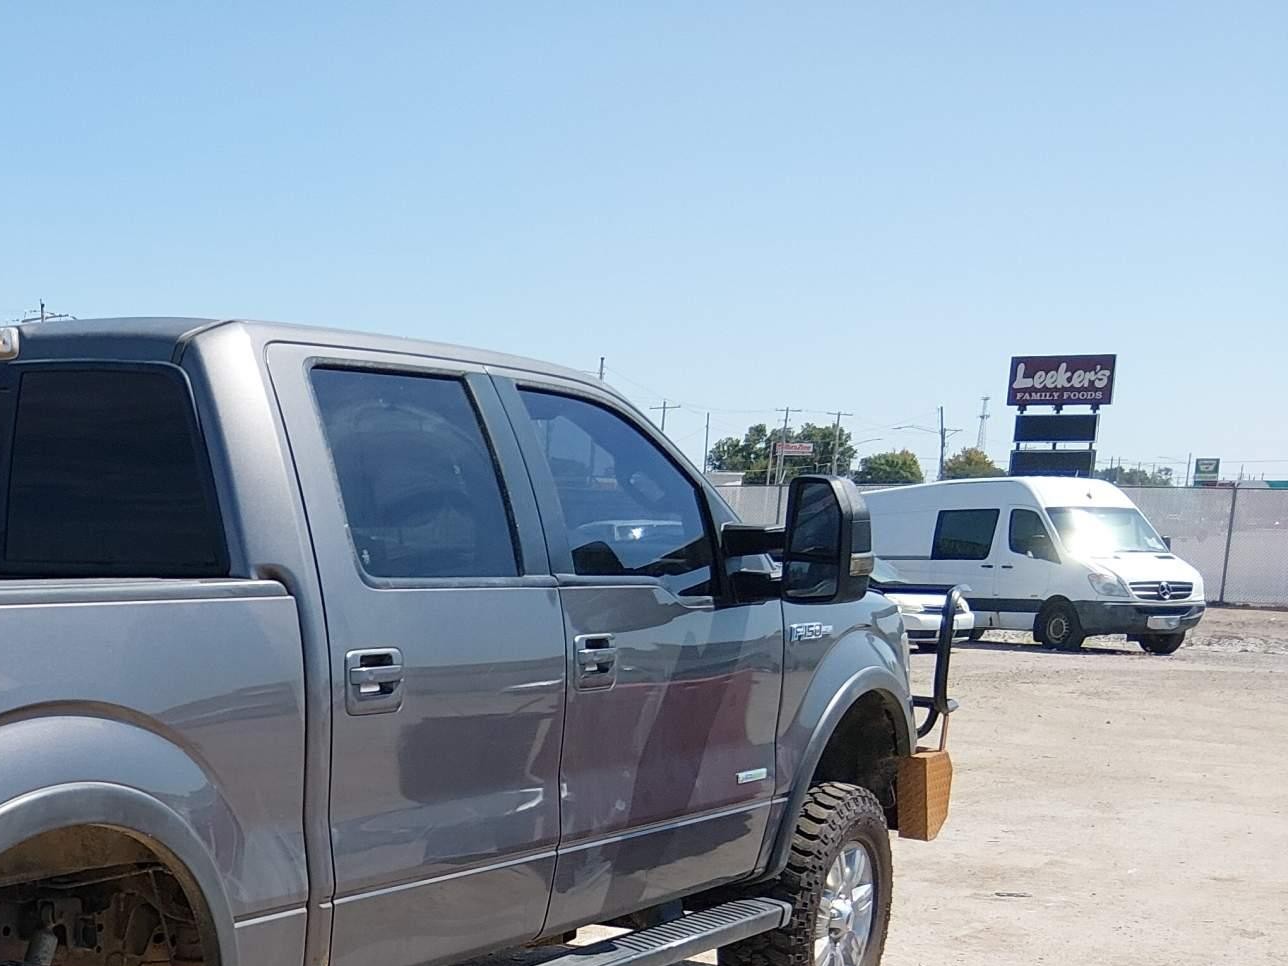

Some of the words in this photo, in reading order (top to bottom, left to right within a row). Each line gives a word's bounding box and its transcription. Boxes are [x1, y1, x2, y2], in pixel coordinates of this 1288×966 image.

[1012, 362, 1111, 389] Leeker's
[1015, 392, 1060, 400] FAMILY
[1062, 391, 1103, 400] FOODS
